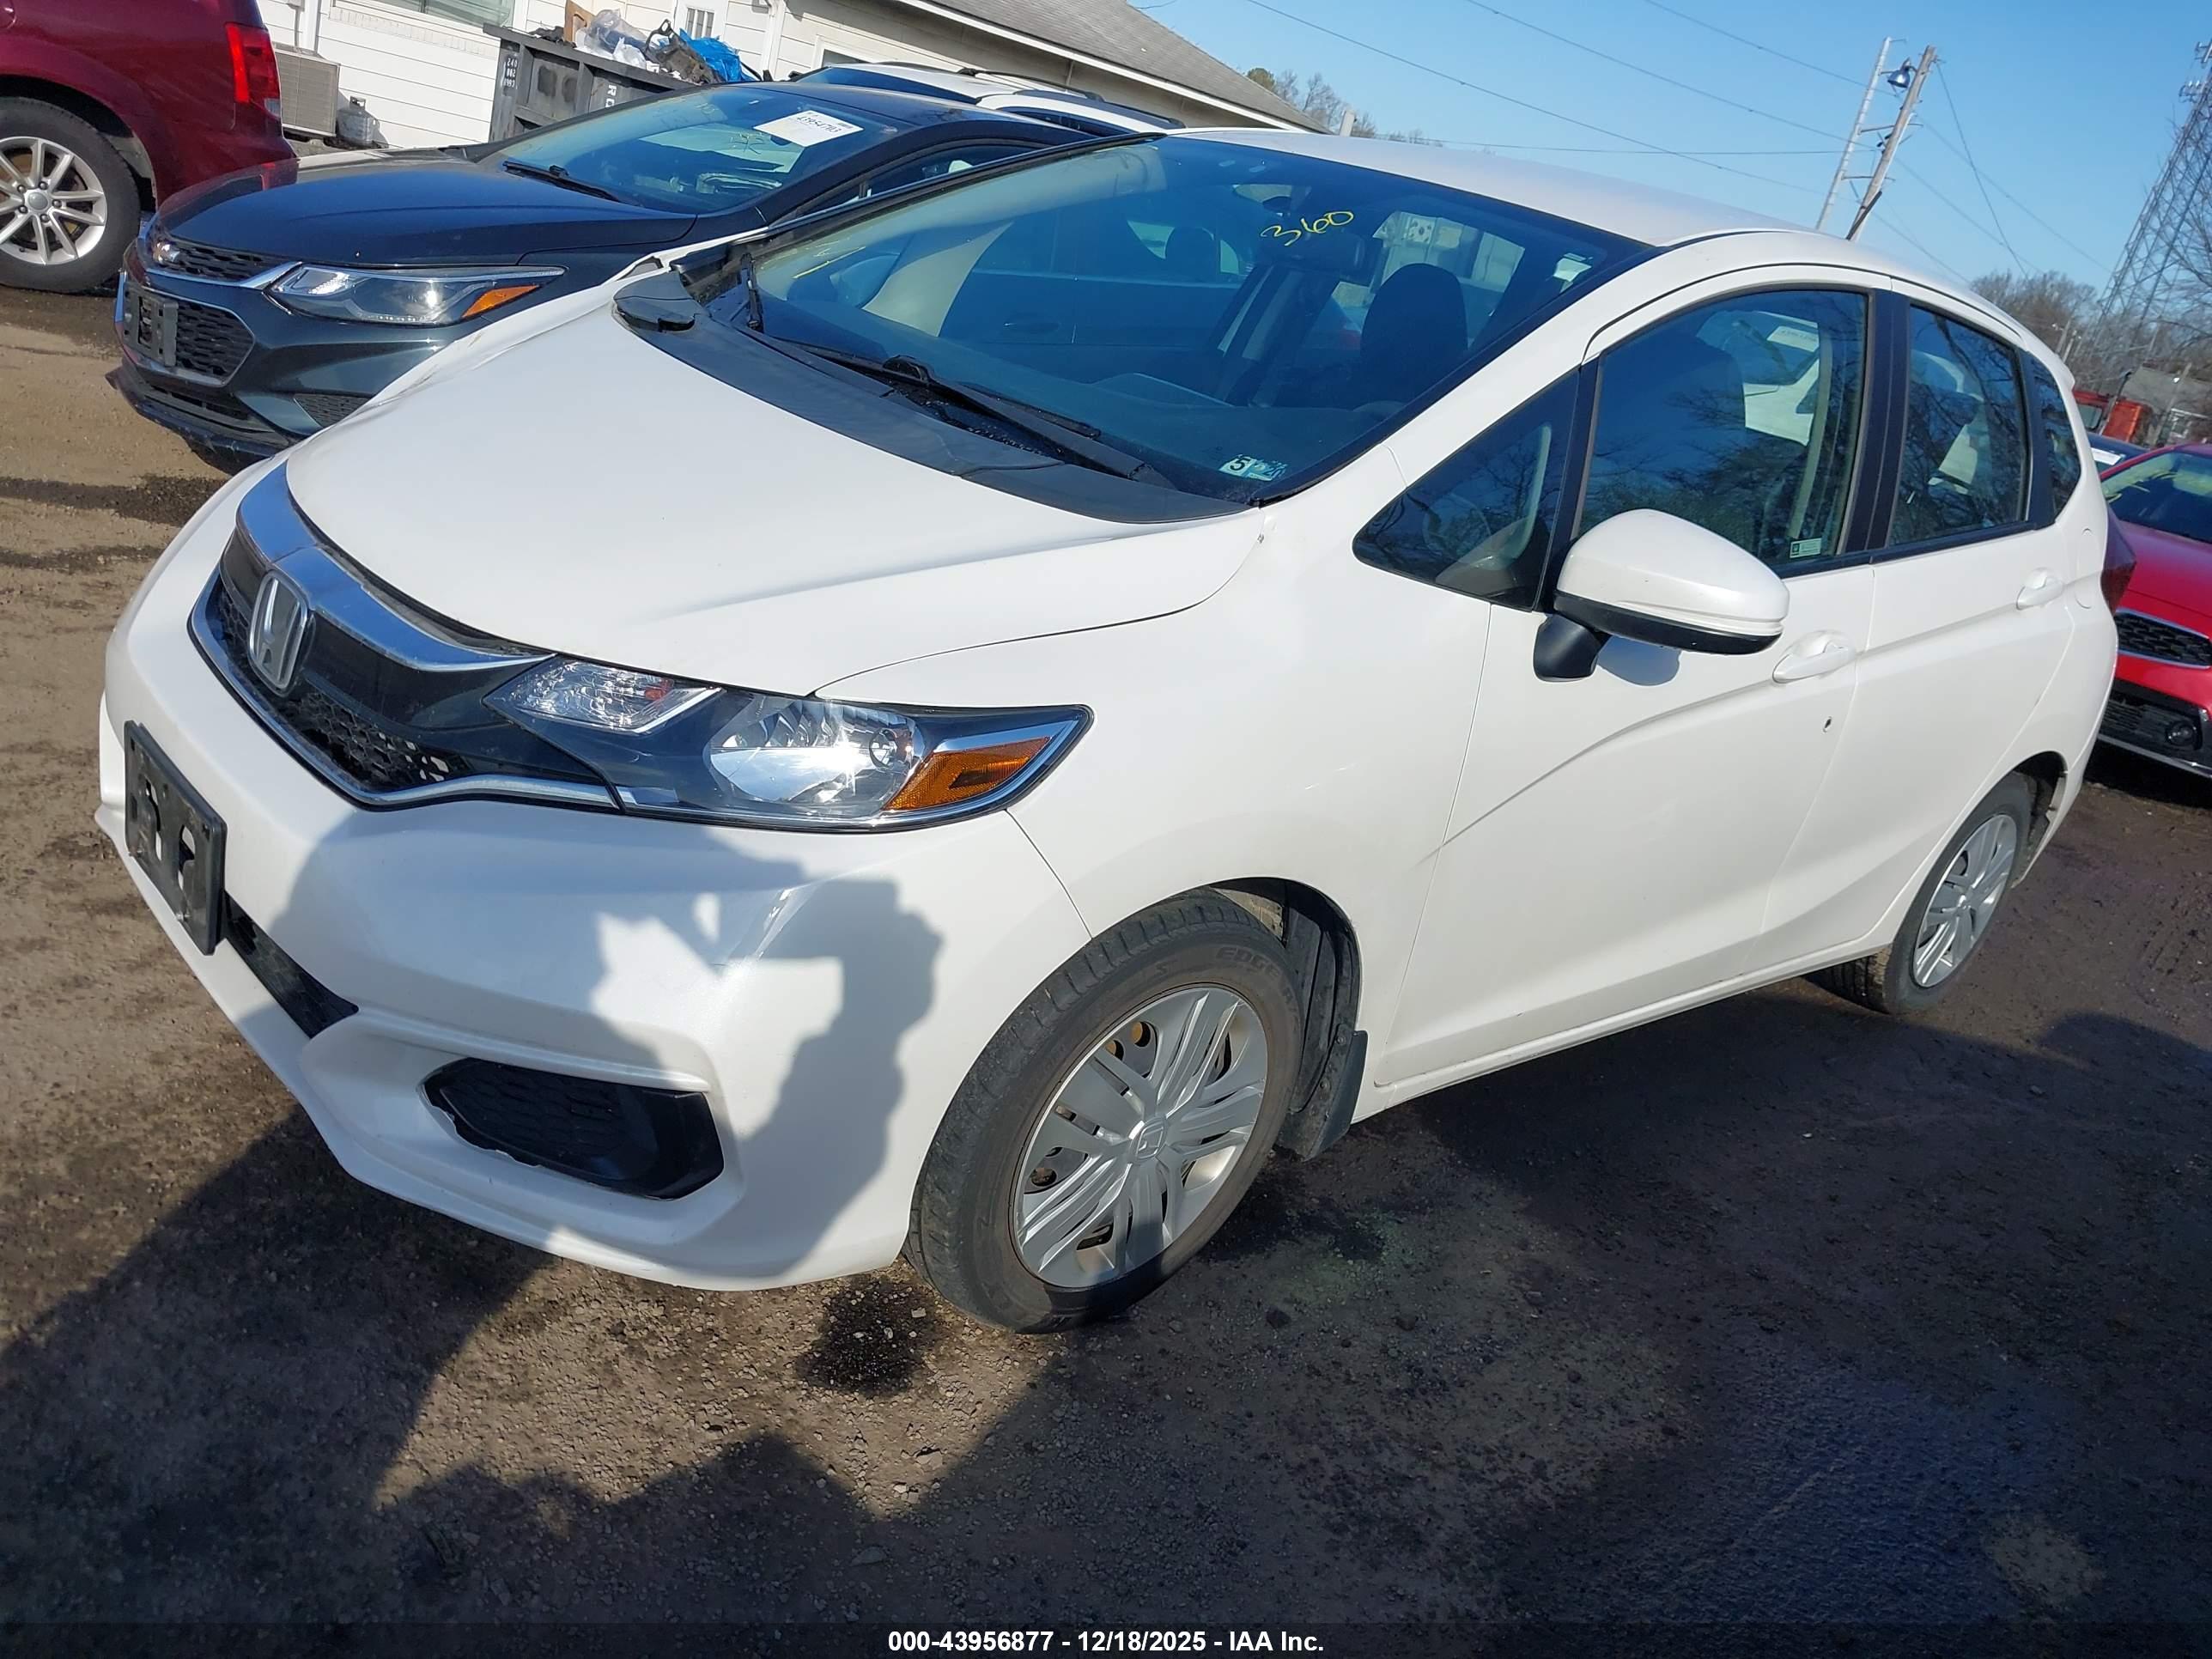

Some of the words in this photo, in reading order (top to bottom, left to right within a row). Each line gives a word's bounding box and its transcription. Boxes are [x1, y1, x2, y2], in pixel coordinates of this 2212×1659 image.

[507, 58, 518, 68] 240
[1260, 210, 1354, 246] 360
[1229, 457, 1251, 471] 5
[1216, 947, 1280, 978] EDGE
